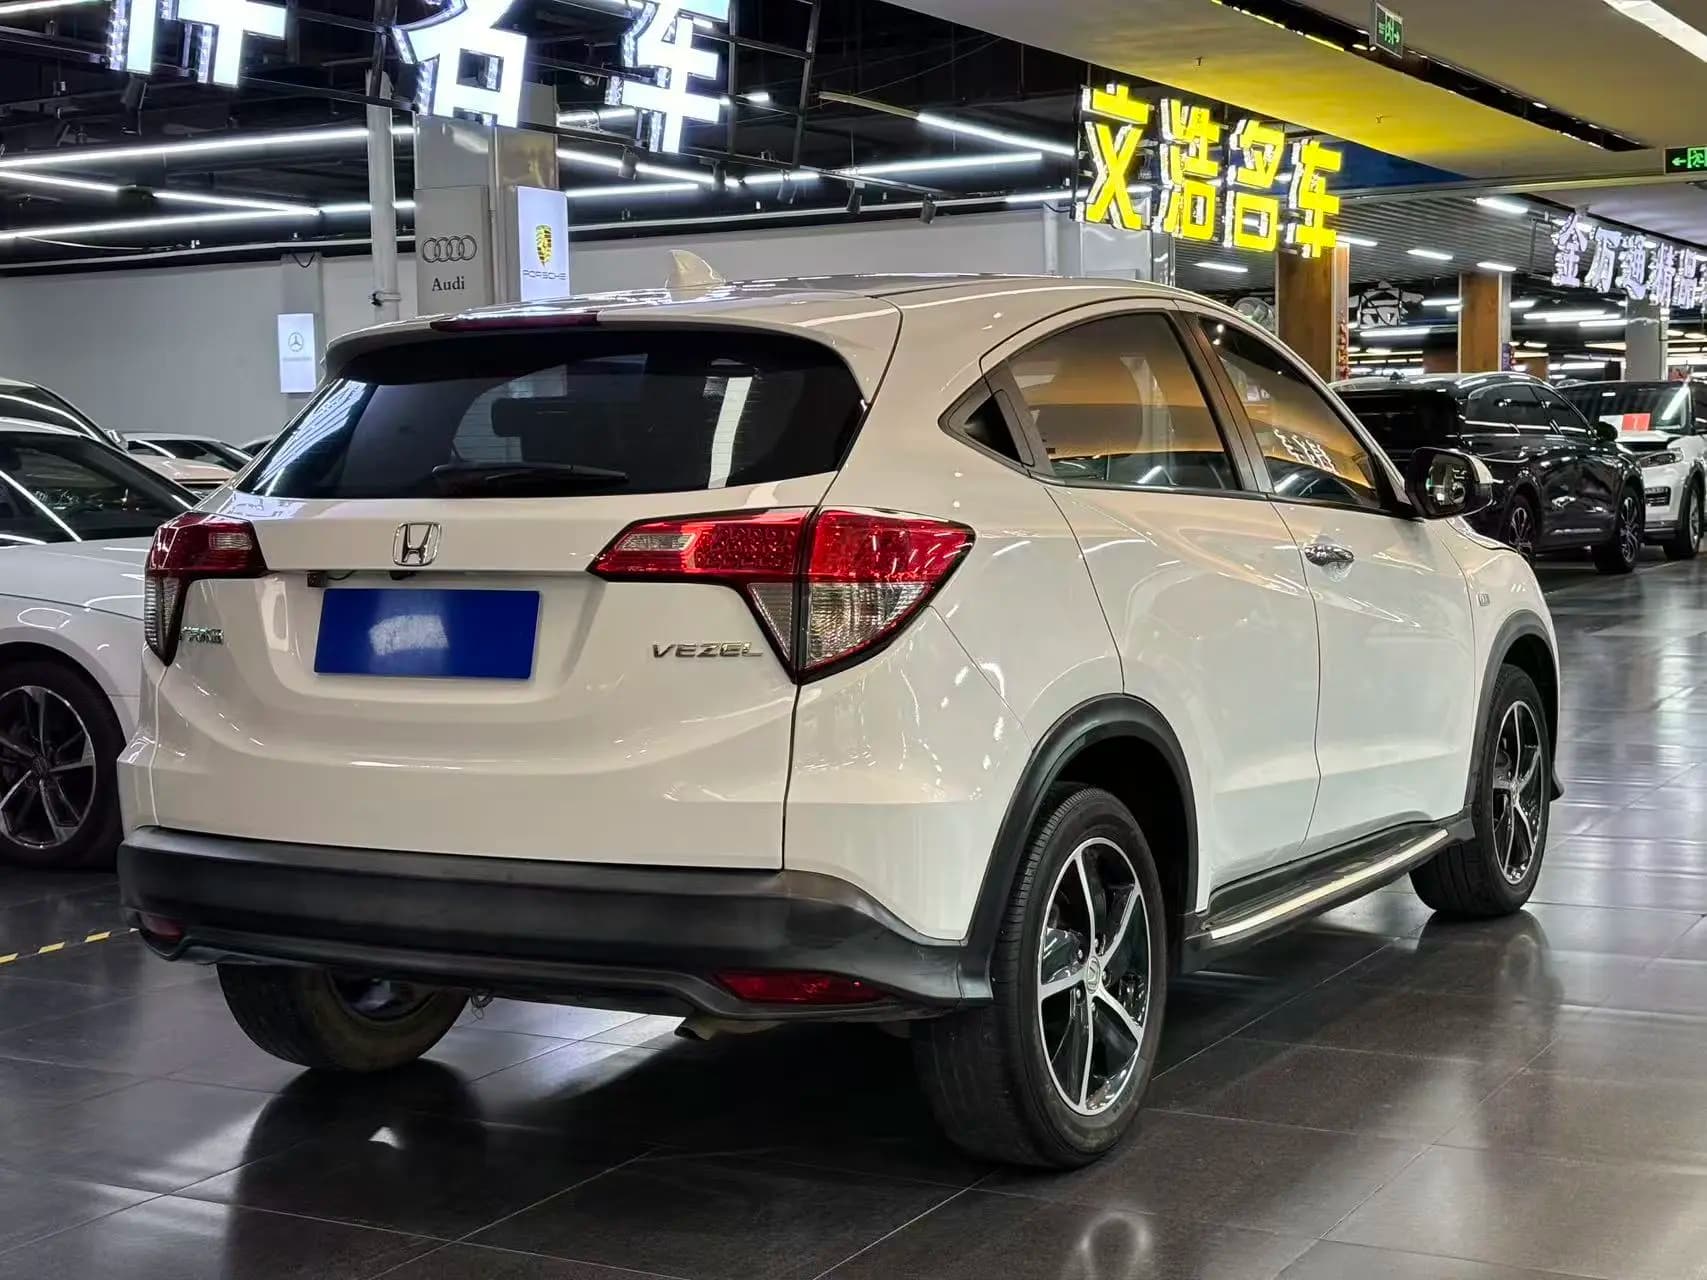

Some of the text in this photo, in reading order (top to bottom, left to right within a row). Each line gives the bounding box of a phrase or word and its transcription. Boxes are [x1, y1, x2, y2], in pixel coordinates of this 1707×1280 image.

[1083, 83, 1342, 258] 文浩名车
[431, 275, 465, 292] Audi
[652, 641, 763, 658] VEZEL
